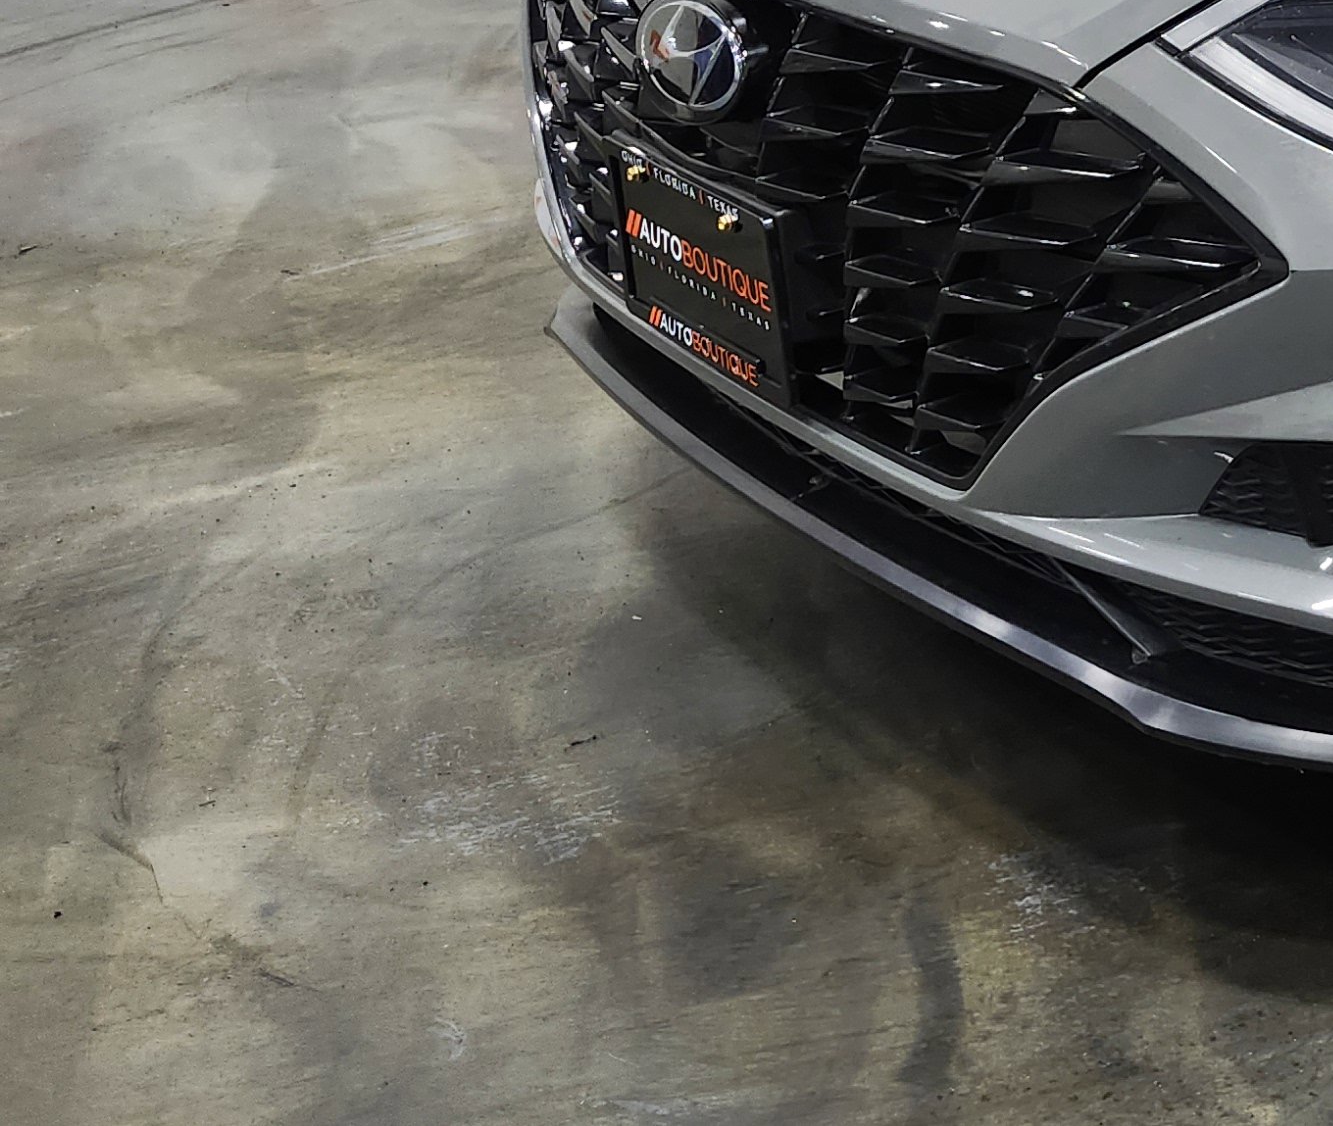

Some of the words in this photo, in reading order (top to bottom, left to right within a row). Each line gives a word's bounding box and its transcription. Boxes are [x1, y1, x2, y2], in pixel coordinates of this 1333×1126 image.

[653, 167, 696, 201] FLORIDA
[707, 195, 739, 222] TEXAS
[639, 218, 772, 312] AUTOBOUTIQUE
[668, 266, 717, 301] FLORIDA
[732, 302, 771, 331] TEXAS
[659, 314, 760, 387] AUTOBOUTIQUE
